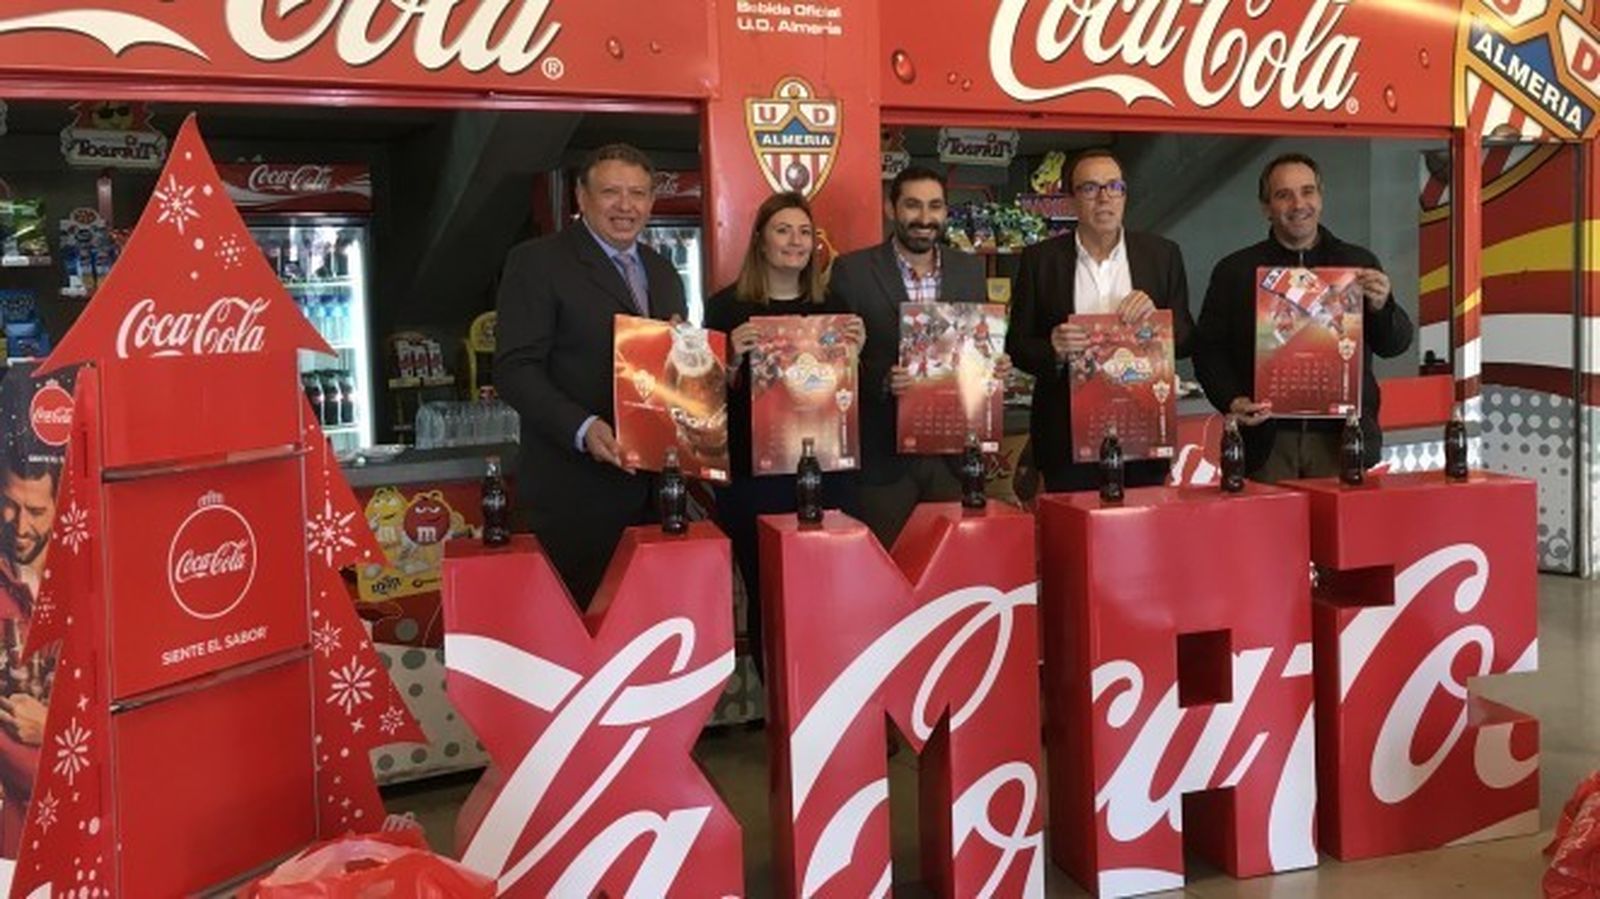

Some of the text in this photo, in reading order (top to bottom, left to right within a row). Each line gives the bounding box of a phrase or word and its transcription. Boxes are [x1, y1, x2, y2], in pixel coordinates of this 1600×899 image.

[736, 0, 842, 18] Bebida Oficial
[1473, 32, 1583, 132] ALMERIA
[758, 106, 776, 122] U
[813, 108, 830, 123] D
[761, 134, 831, 146] ALMERIA
[116, 297, 272, 359] Coca-Cola
[175, 538, 250, 584] Coca-Cola
[161, 625, 268, 666] SIENTE EL SABOR
